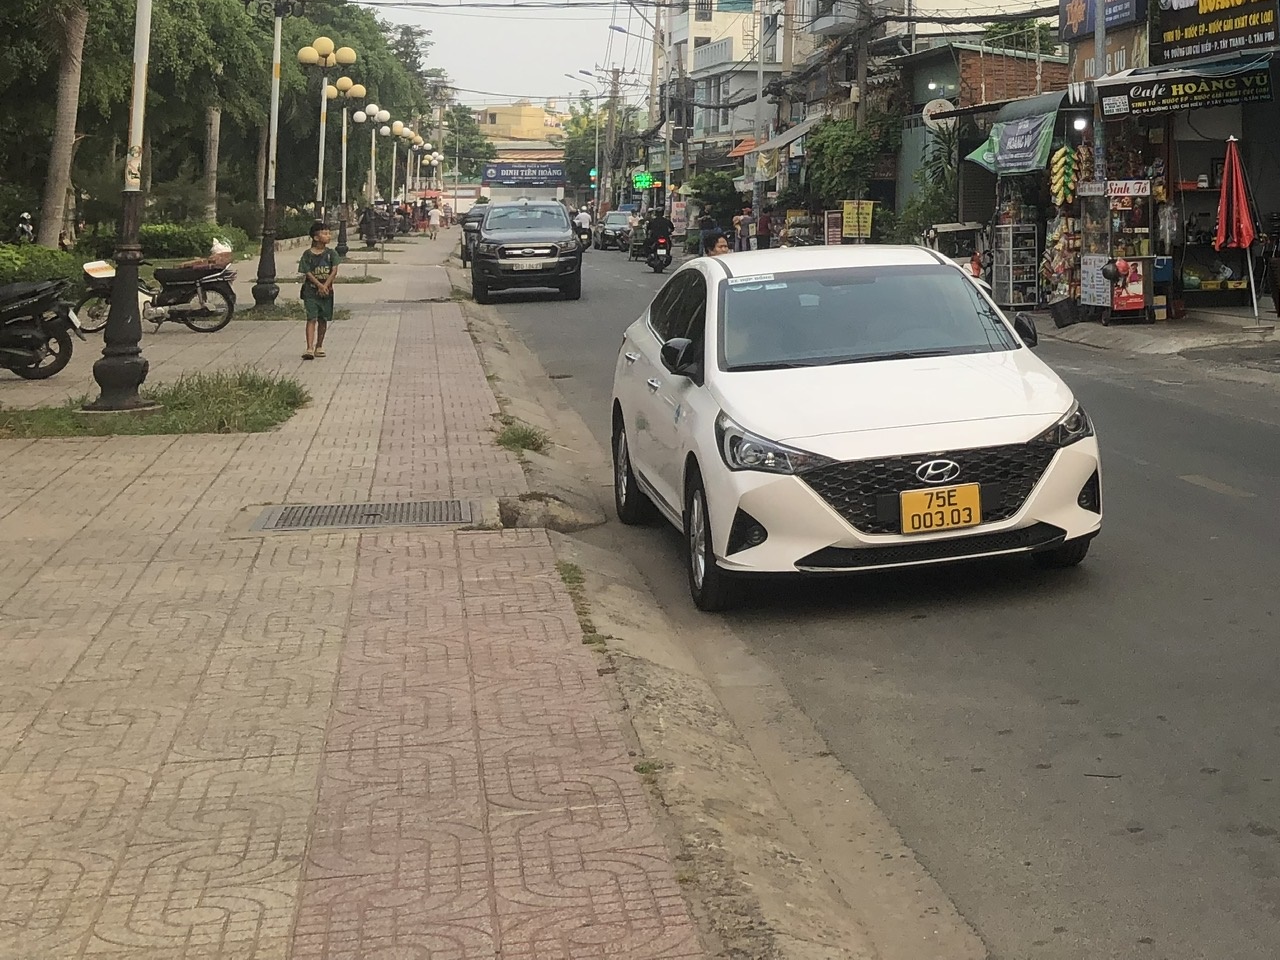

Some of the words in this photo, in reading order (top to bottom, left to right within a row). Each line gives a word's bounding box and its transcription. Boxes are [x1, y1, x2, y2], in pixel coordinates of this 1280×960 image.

[1130, 84, 1166, 99] Café
[1171, 78, 1237, 96] HOÀNG
[1241, 73, 1268, 87] VŨ
[1107, 182, 1130, 194] Sinh
[1134, 181, 1149, 193] Tố
[924, 489, 957, 509] 75E
[911, 507, 972, 530] 003.03
